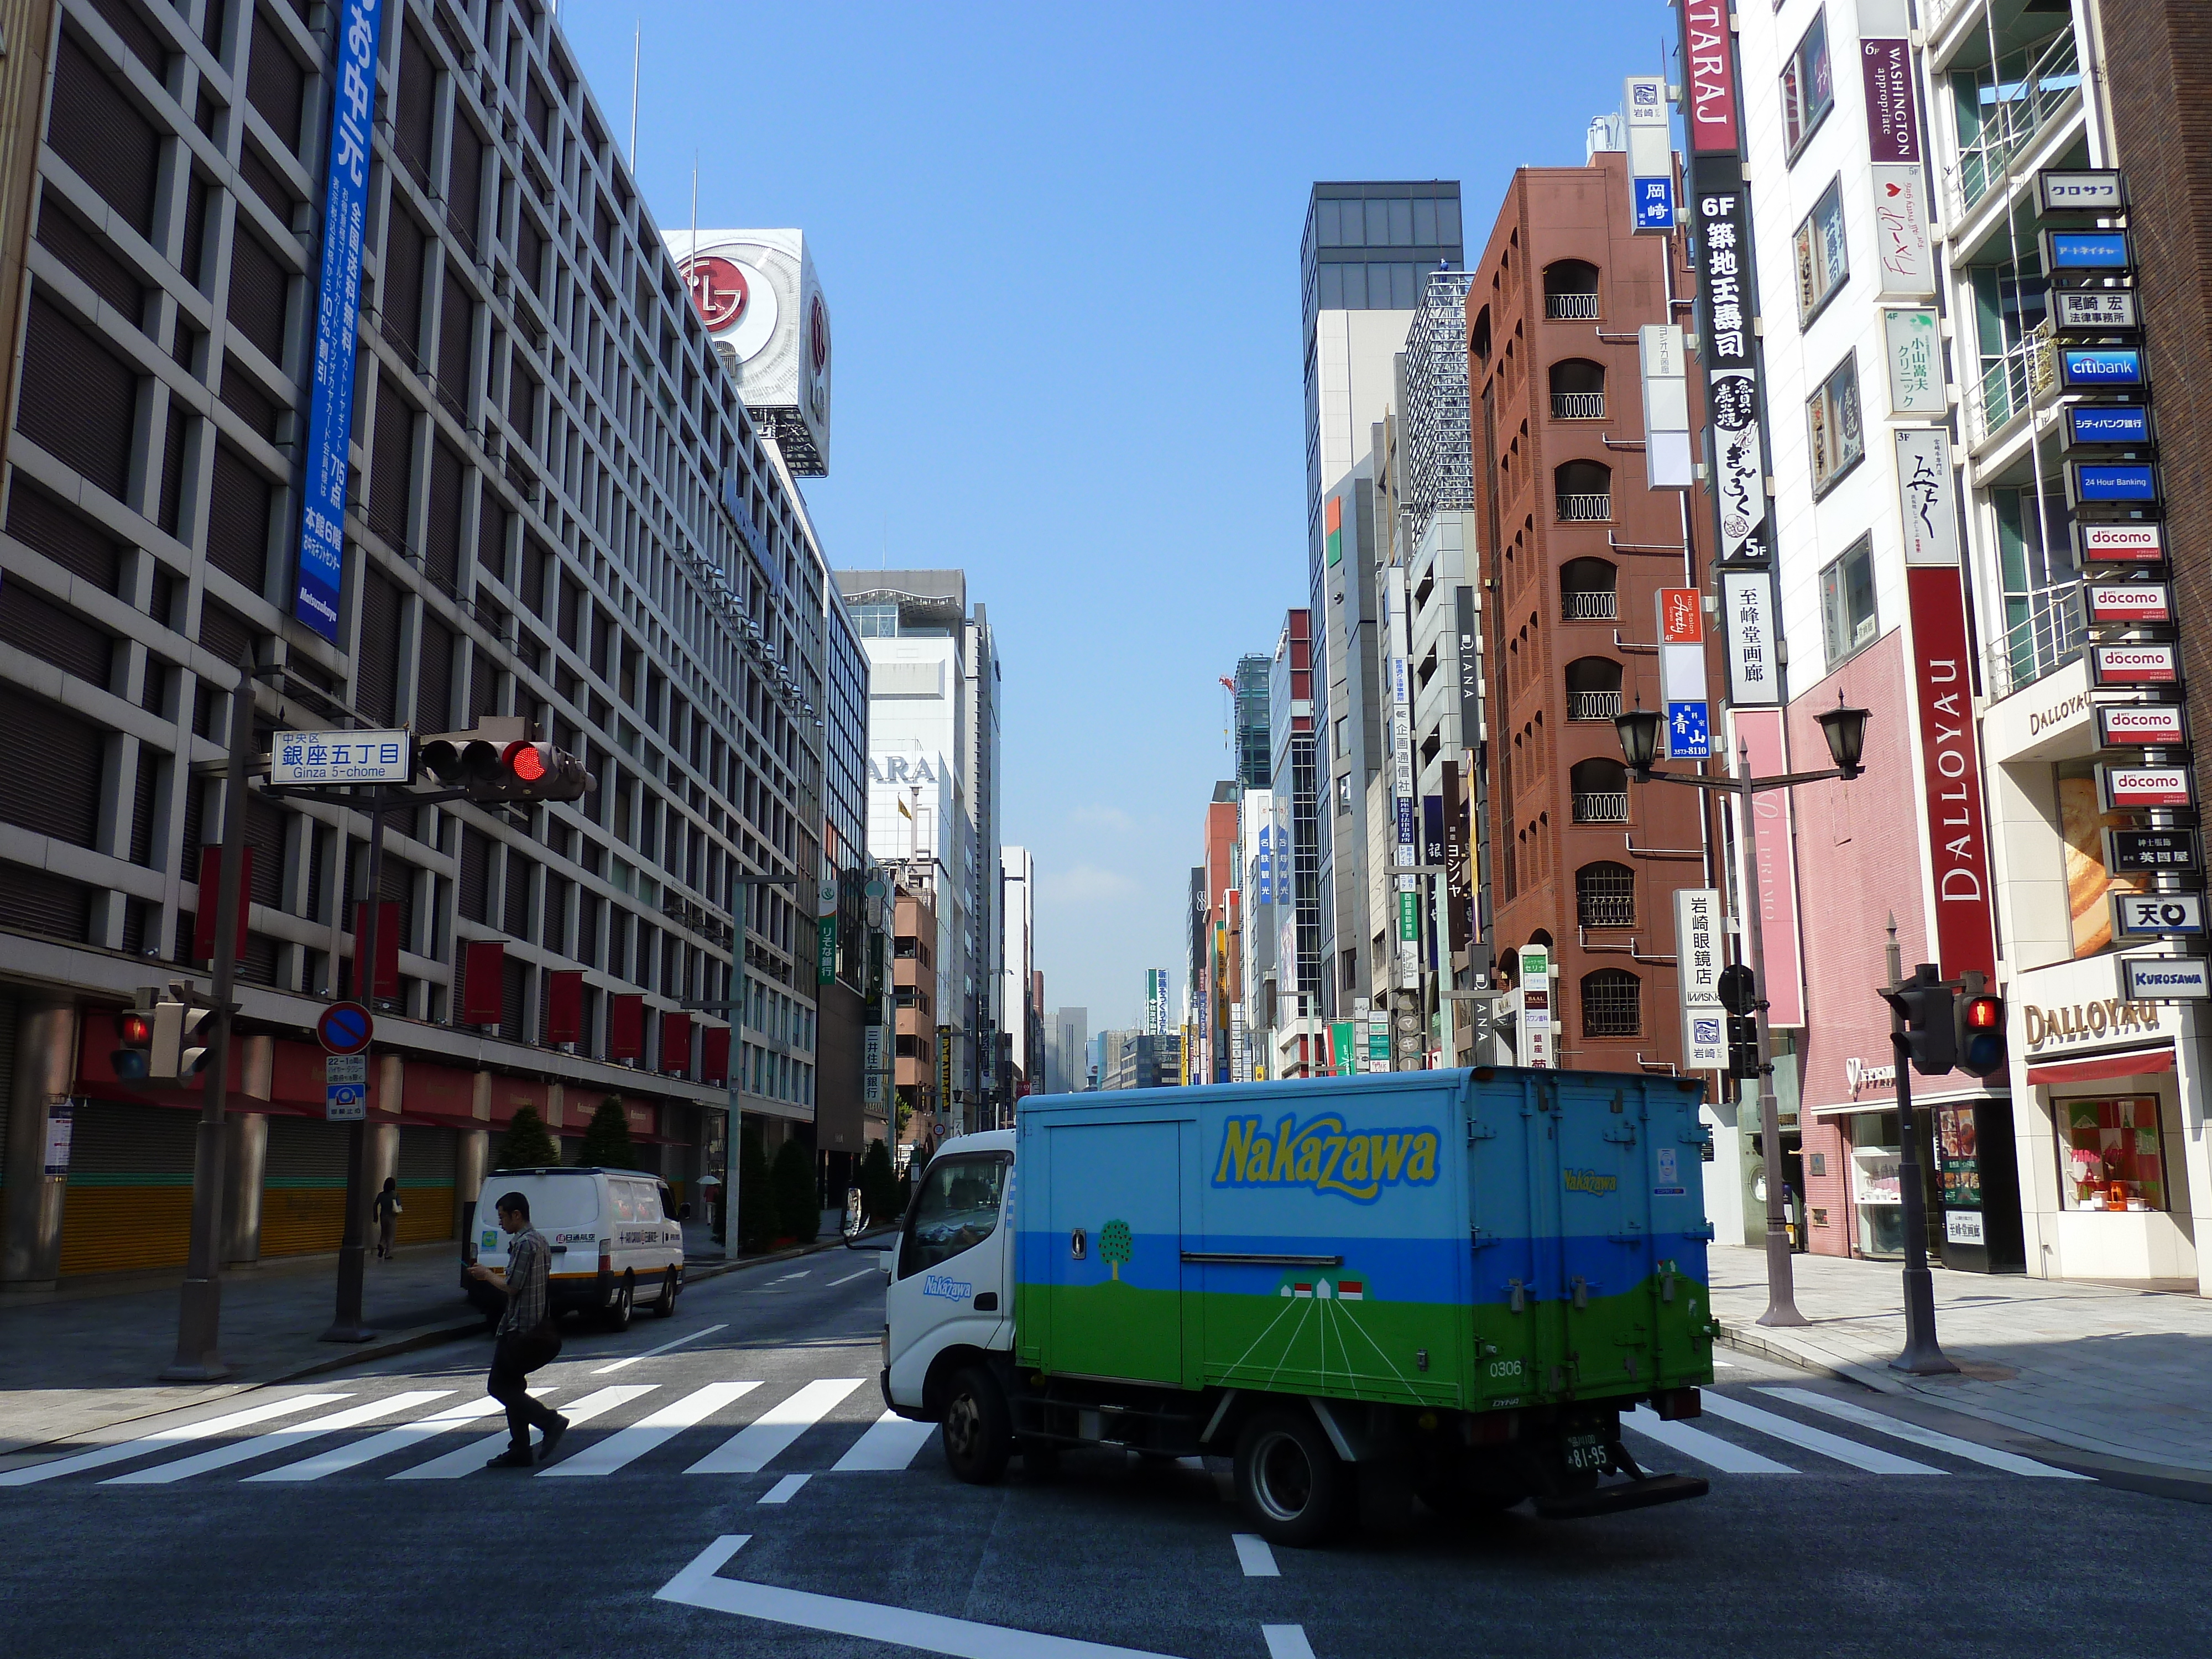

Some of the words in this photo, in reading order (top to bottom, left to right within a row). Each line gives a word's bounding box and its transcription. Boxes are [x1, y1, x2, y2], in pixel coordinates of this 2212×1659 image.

[1865, 42, 1880, 55] 6F
[1688, 0, 1727, 124] TARAJ
[1875, 68, 1891, 135] appropriate
[1889, 48, 1910, 155] WASHINGTON
[1909, 167, 1918, 175] 5F
[1646, 184, 1668, 220] 岡崎
[2051, 186, 2114, 195] クロサワ
[1702, 197, 1735, 216] 6F
[2058, 246, 2119, 255] アートネイチャー
[2068, 296, 2098, 310] 尾崎
[2107, 296, 2122, 310] 宏
[2069, 312, 2125, 323] 法律事務所
[1898, 346, 1913, 408] クリニック
[2072, 358, 2132, 373] citibank
[2075, 419, 2142, 428] シティバンク銀行
[1898, 432, 1910, 441] 3F
[1723, 442, 1757, 516] ぎんろく
[2116, 478, 2146, 487] Banking
[1906, 455, 1939, 539] みやちく
[306, 506, 342, 552] 本館6階
[2092, 531, 2151, 542] docomo
[304, 534, 340, 570] お中元ギフトセンター
[1745, 538, 1767, 557] 5F
[300, 587, 337, 622] Matsuzakaya
[2098, 591, 2157, 603] docomo
[1739, 588, 1764, 682] 至峰堂画廊
[1460, 634, 1474, 699] DIANA
[2105, 652, 2164, 664] docomo
[1672, 712, 1706, 744] 青山
[2112, 713, 2172, 725] docomo
[283, 733, 320, 744] 中央区
[282, 744, 399, 765] 銀座五丁目
[1395, 722, 1410, 792] 企画通信社
[1673, 747, 1707, 755] 3573-8110
[294, 767, 326, 778] Ginza
[332, 766, 385, 777] 5-chome
[1929, 658, 1981, 902] DALLOYAU
[2118, 775, 2178, 787] docomo
[1260, 838, 1270, 895] 名鉄観光
[1447, 845, 1463, 898] ヨシノヤ
[822, 927, 832, 977] りそな銀行
[1691, 897, 1712, 985] 岩崎眼鏡店
[1405, 950, 1417, 979] Ash
[2135, 973, 2202, 985] KUROSAWA
[1475, 974, 1489, 1042] DANA
[2023, 998, 2158, 1045] DALLOYAU
[1533, 1034, 1543, 1053] 銀座
[1215, 1113, 1438, 1202] Nakazawa
[1563, 1167, 1618, 1196] Nakazawa
[924, 1274, 972, 1302] Nakazawa
[1490, 1360, 1522, 1378] 0306
[1492, 1399, 1520, 1407] DYNA
[1573, 1444, 1607, 1468] 81-95
